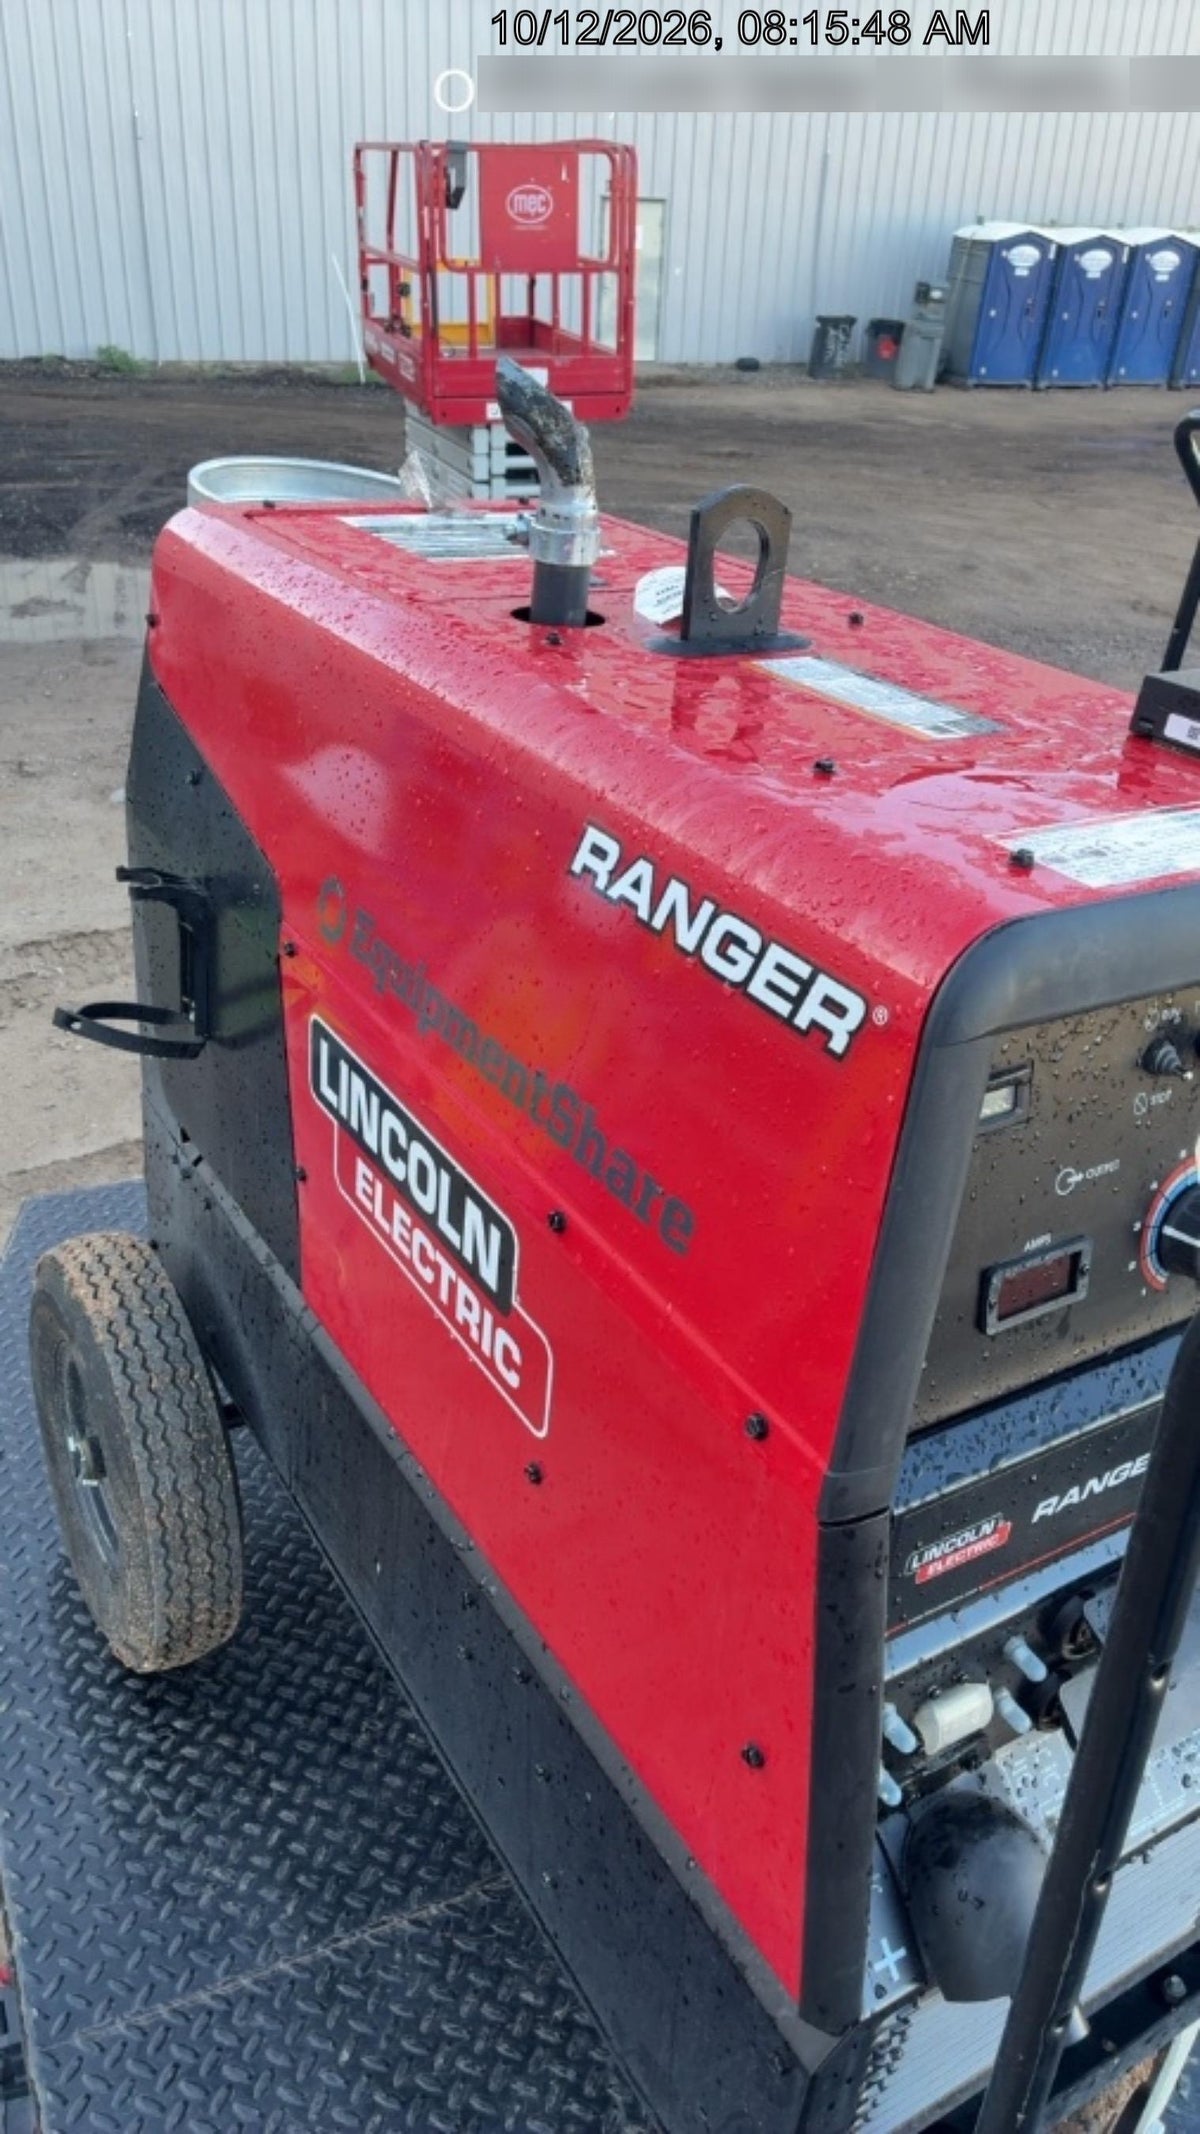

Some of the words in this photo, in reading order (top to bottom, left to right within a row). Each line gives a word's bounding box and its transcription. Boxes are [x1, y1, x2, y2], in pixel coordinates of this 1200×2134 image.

[318, 1037, 502, 1294] LINCOLN
[348, 907, 697, 1256] EquipmentShare
[354, 1156, 523, 1389] ELECTRIC
[912, 1518, 997, 1569] LINCOLN
[927, 1532, 1000, 1578] ELECTRIC
